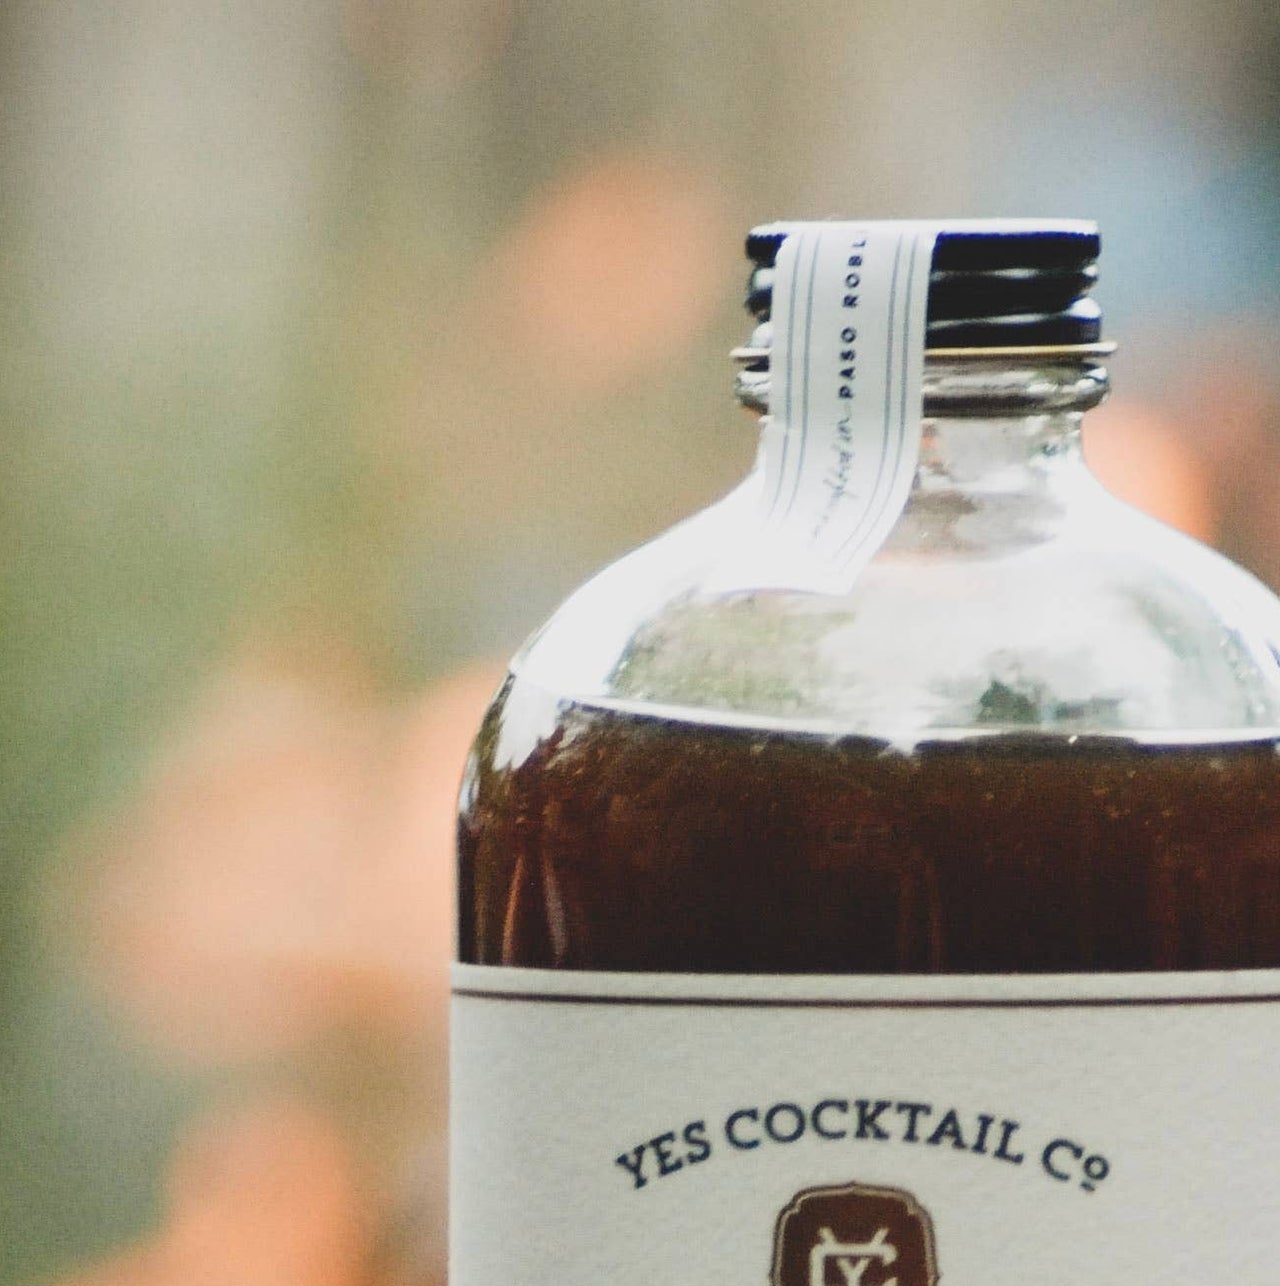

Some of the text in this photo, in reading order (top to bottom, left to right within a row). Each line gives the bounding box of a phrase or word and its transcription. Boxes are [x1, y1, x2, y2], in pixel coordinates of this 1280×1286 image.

[842, 236, 867, 308] ROBL
[838, 327, 857, 398] PASO
[615, 1120, 712, 1190] YES
[724, 1099, 1024, 1166] COCKTAIL
